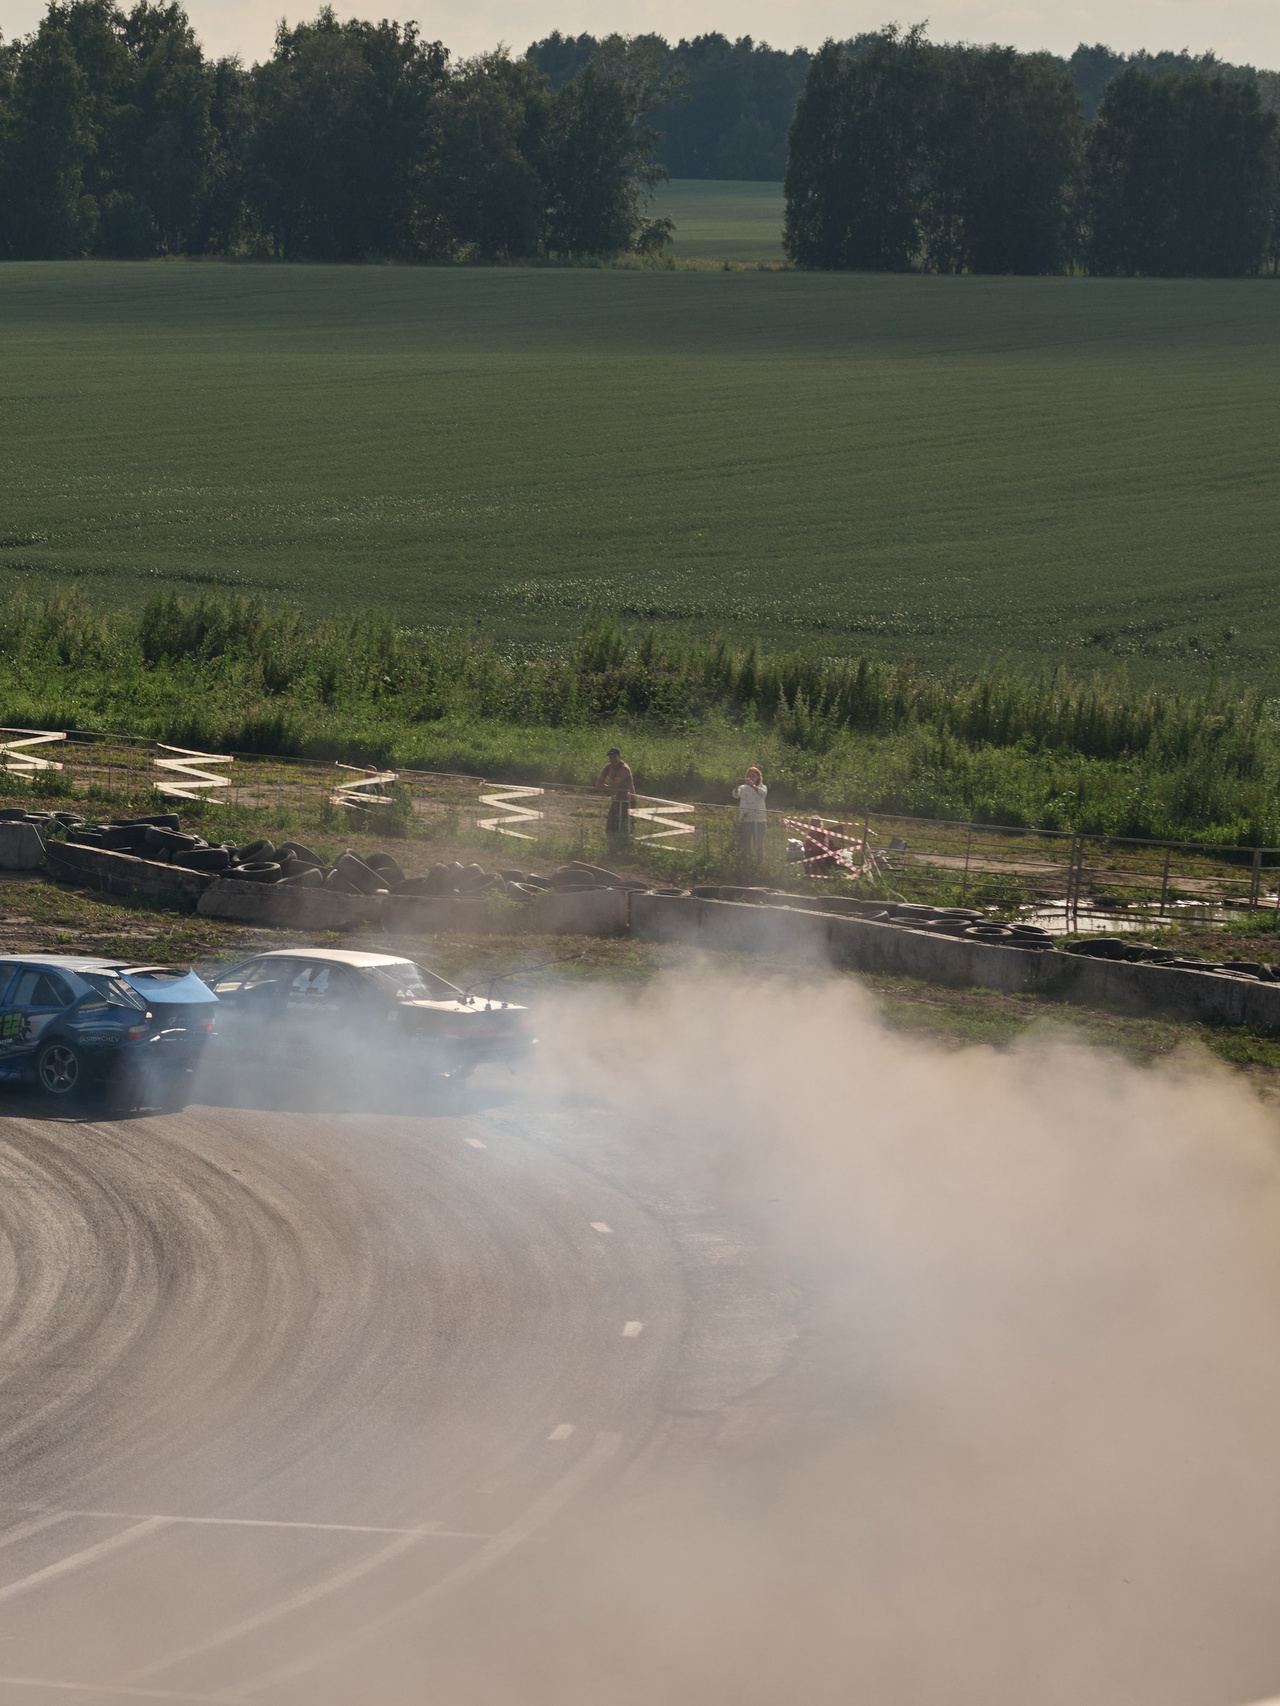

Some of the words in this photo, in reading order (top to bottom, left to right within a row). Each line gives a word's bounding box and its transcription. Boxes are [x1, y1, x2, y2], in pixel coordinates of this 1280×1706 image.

[292, 968, 330, 993] 44
[396, 989, 416, 998] 44
[2, 1013, 23, 1036] 22
